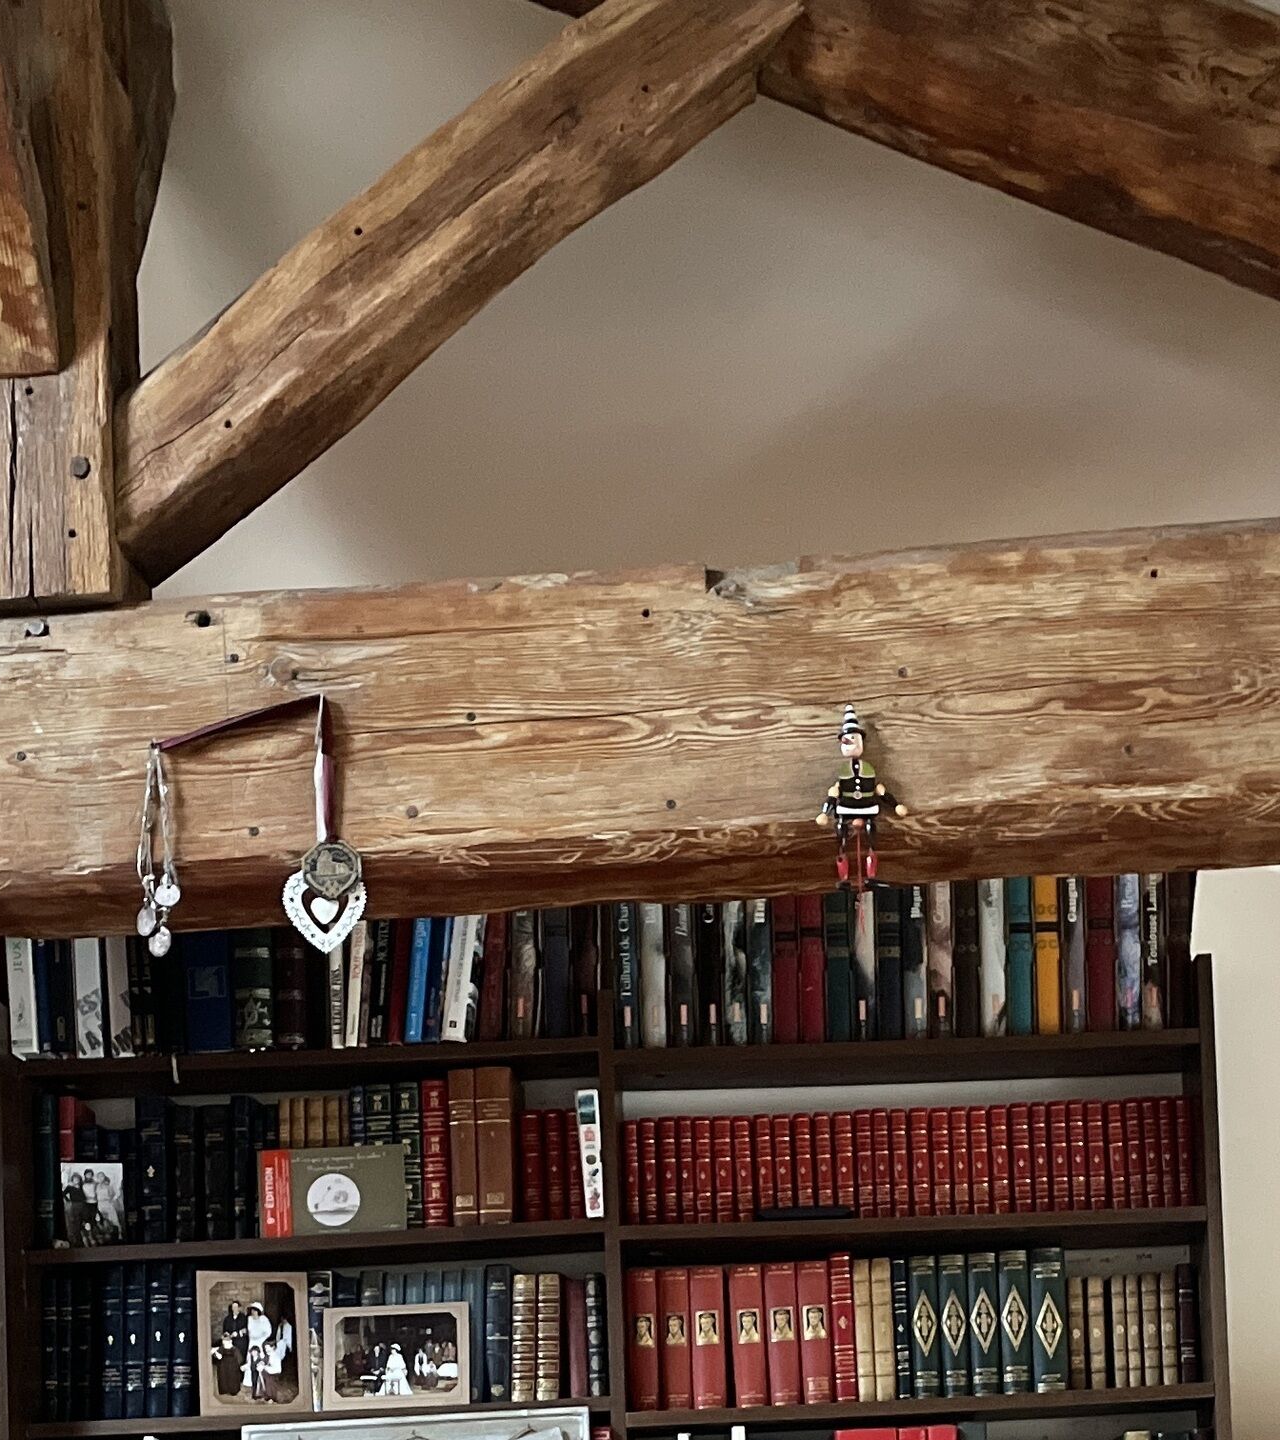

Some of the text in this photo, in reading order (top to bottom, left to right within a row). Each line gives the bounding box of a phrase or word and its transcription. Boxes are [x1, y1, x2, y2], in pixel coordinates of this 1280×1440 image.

[618, 903, 629, 933] Char
[1067, 878, 1078, 922] Gaugui
[619, 938, 630, 952] de
[1147, 913, 1157, 966] Toulouse
